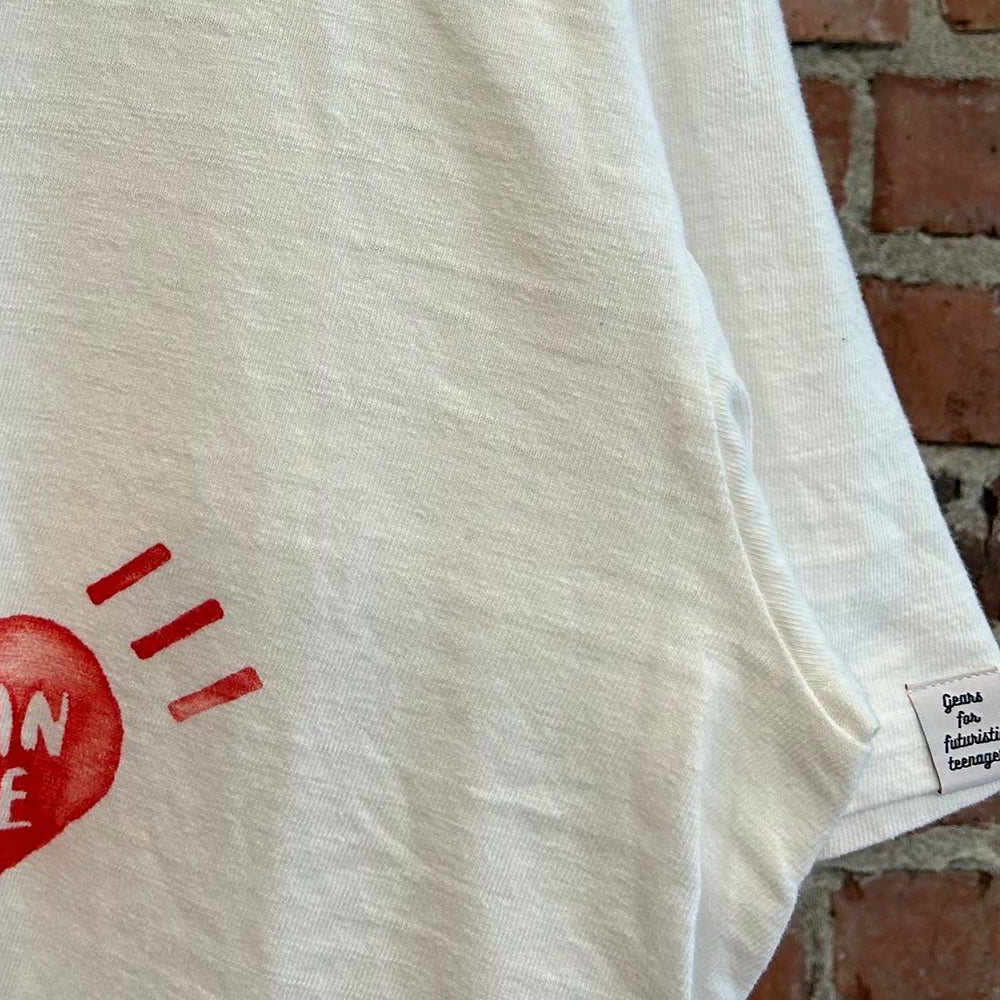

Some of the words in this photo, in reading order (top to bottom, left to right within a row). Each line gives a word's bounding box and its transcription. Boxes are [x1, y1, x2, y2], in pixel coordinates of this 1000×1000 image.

[943, 691, 983, 713] Gears
[956, 710, 981, 728] for
[944, 726, 1000, 753] futuristi
[948, 751, 1000, 771] teenage
